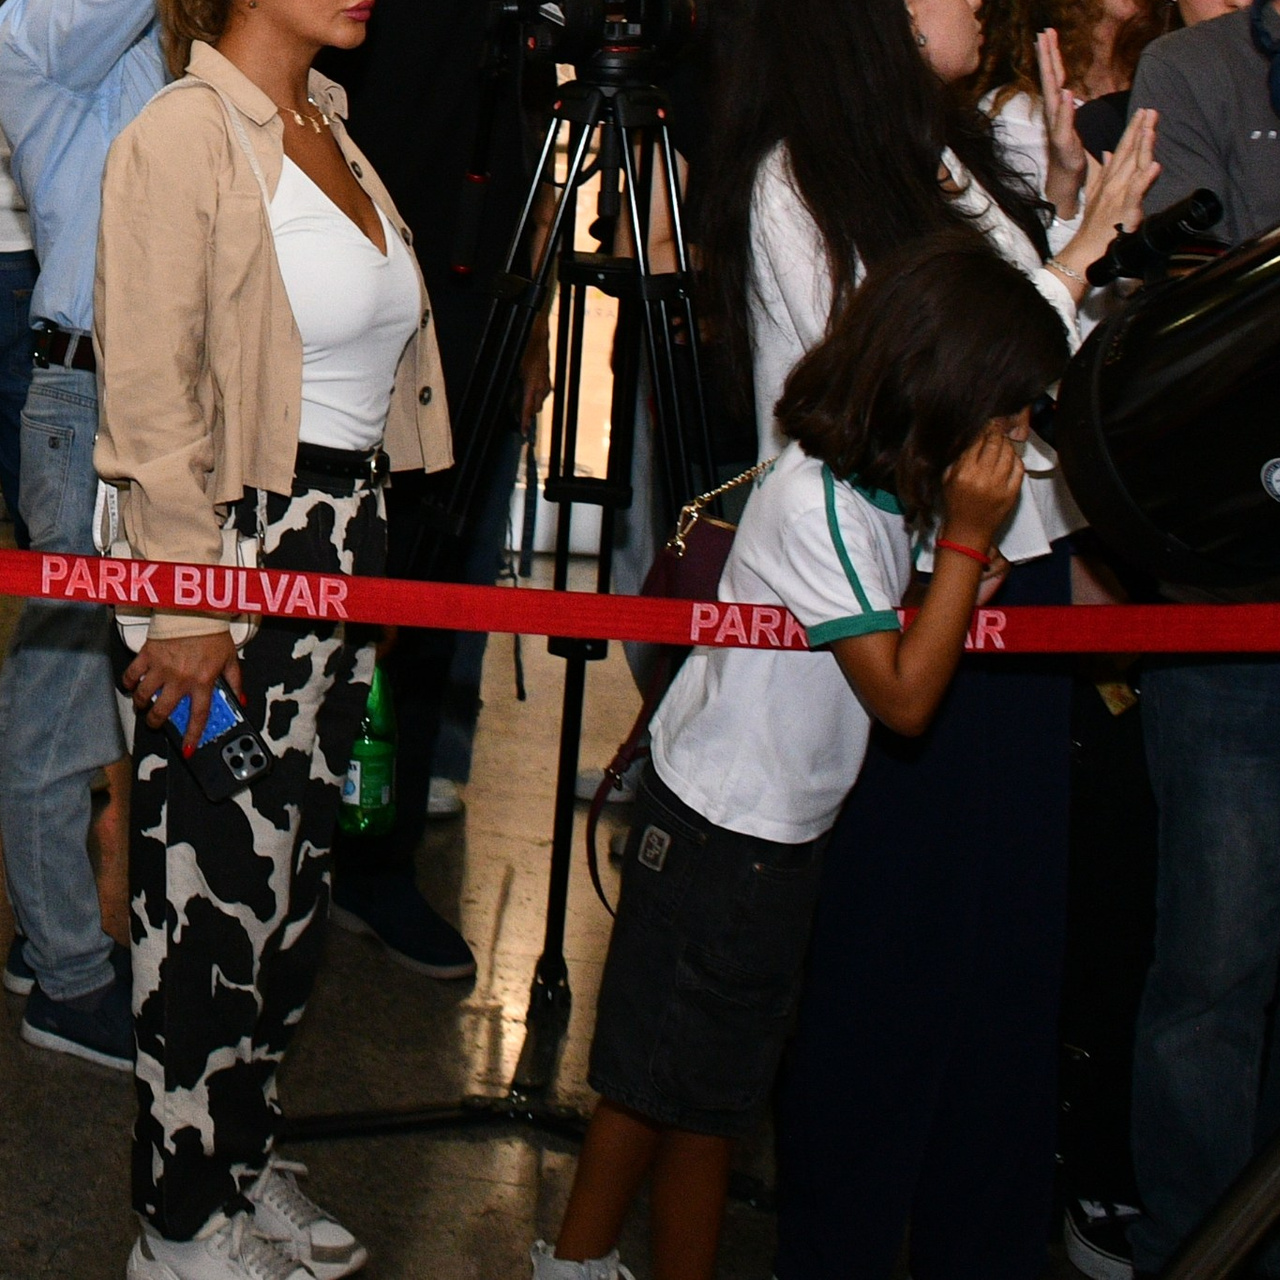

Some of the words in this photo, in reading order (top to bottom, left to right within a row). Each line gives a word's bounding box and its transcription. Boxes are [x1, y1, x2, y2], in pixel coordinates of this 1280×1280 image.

[41, 554, 159, 604] PARK
[174, 565, 349, 618] BULVAR
[690, 603, 810, 647] PARK
